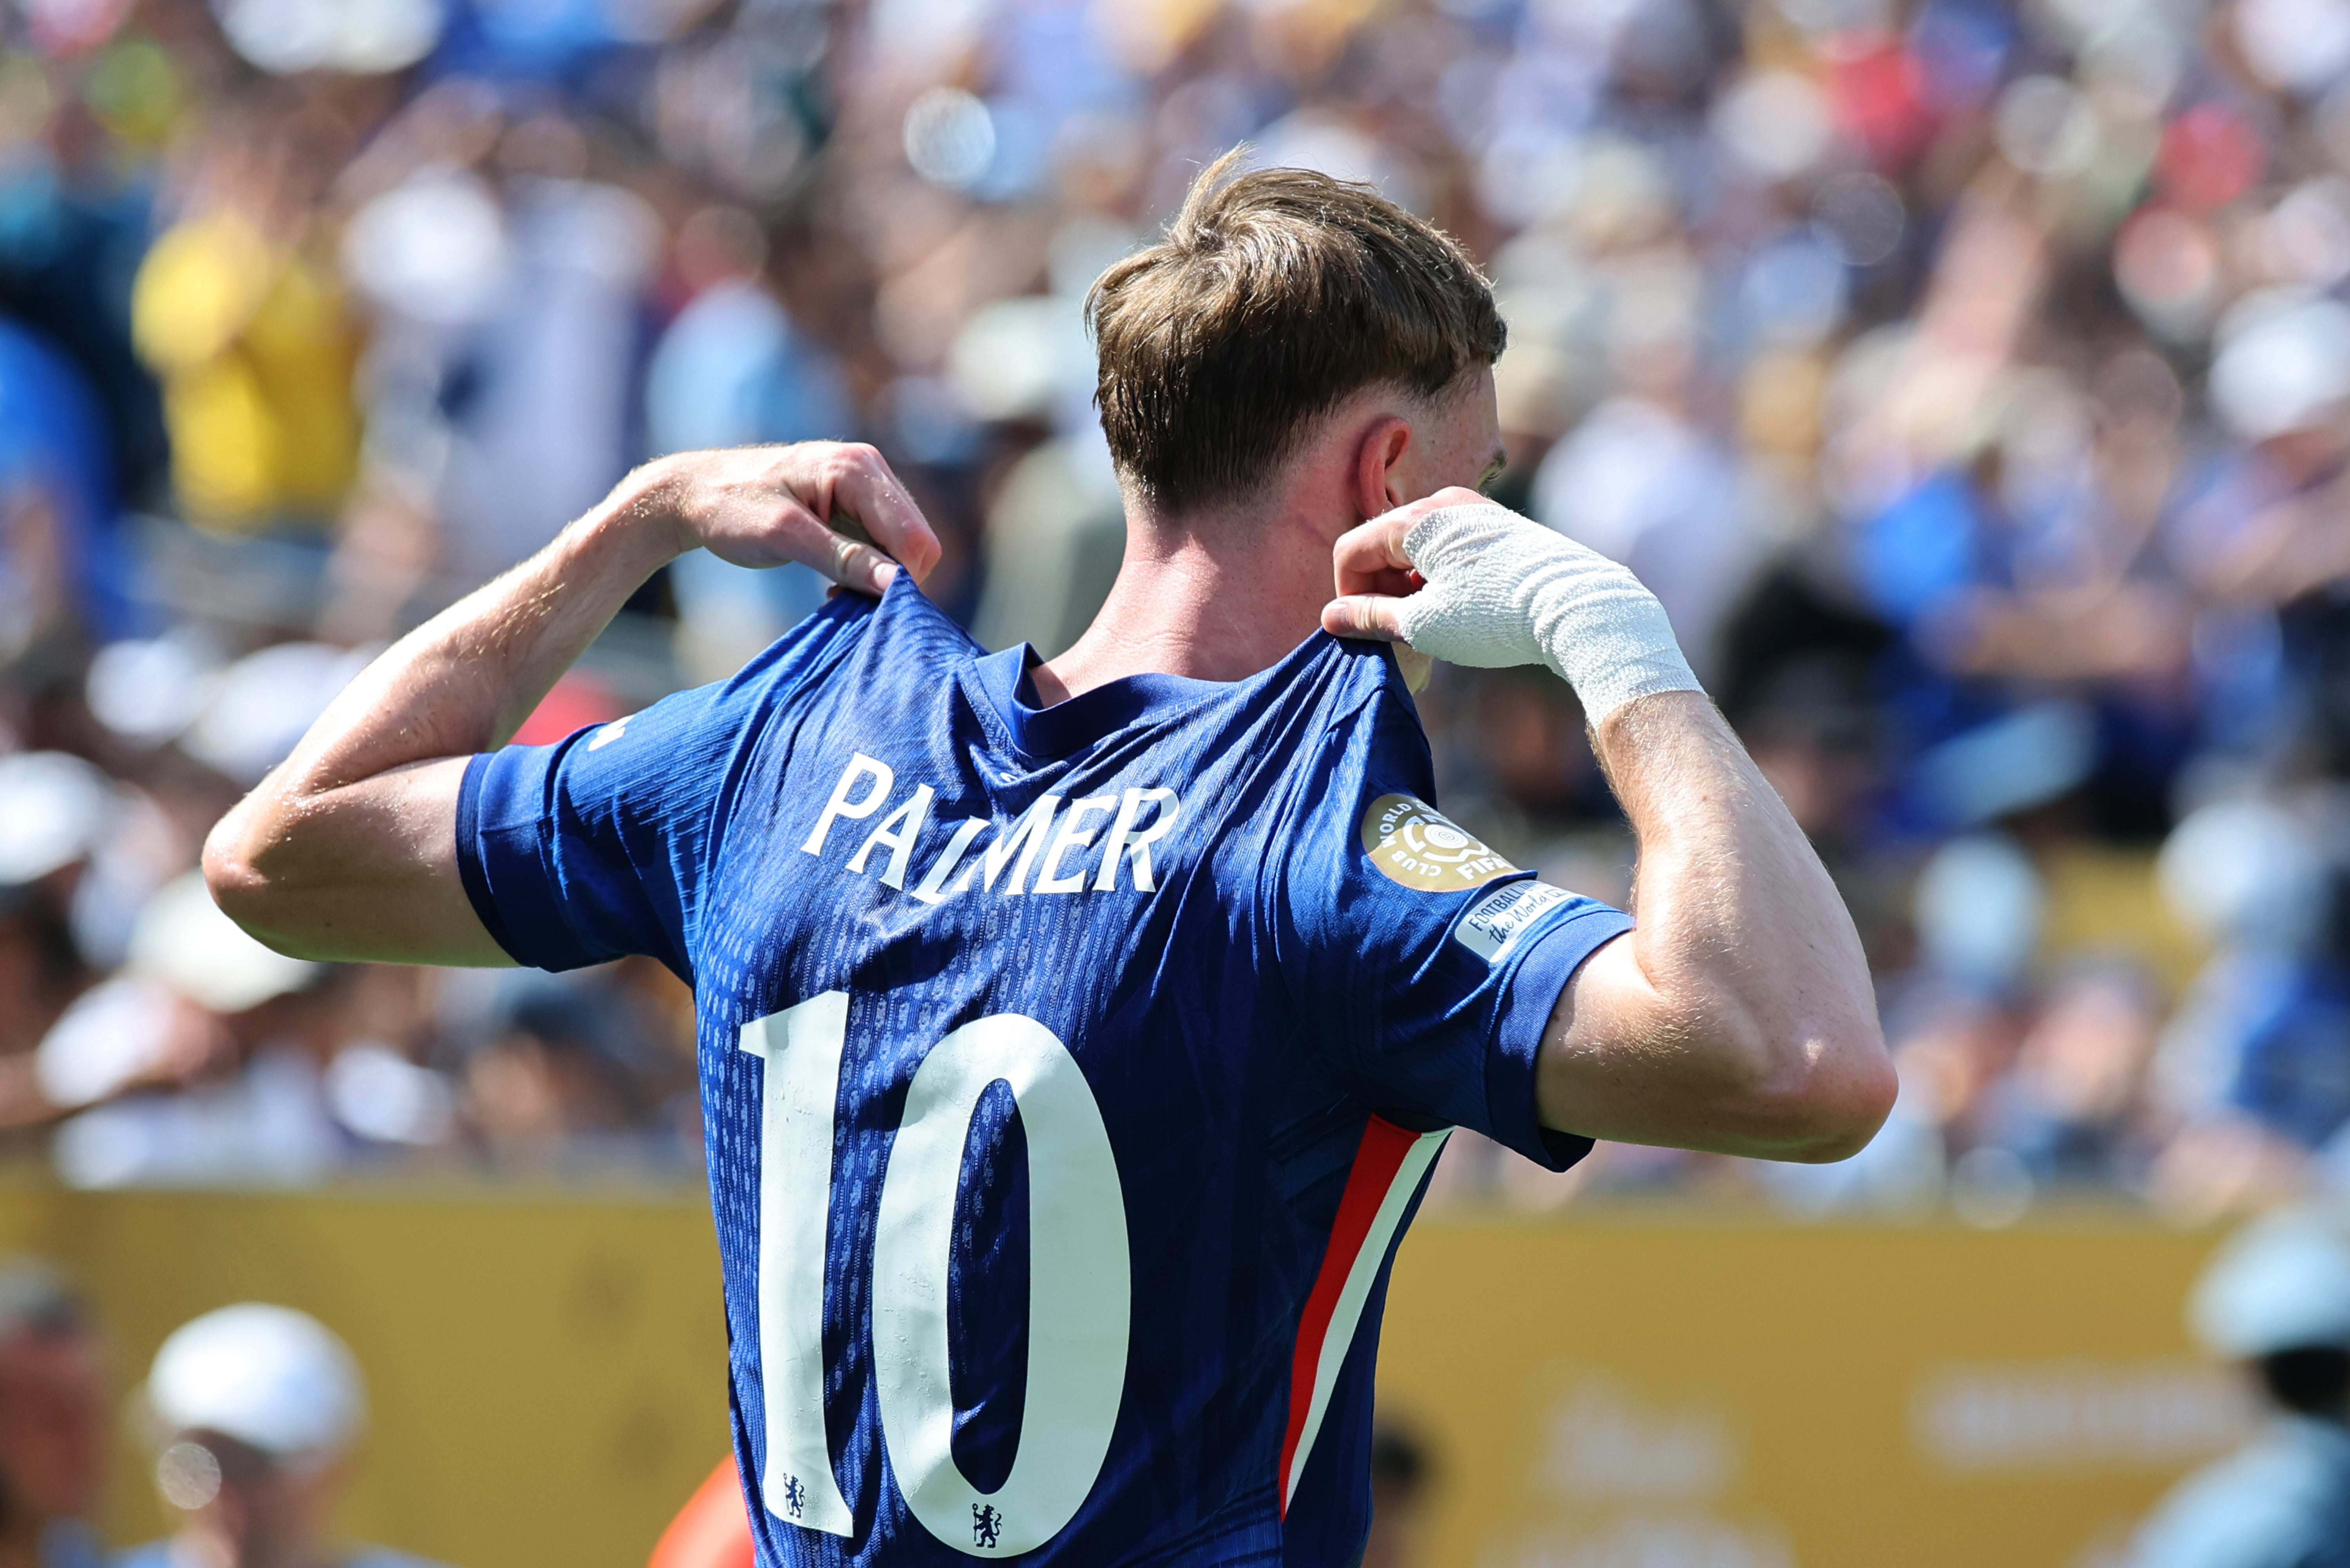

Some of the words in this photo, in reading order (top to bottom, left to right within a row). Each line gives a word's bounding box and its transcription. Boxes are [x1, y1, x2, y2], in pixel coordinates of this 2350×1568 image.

[800, 751, 1179, 905] PALMER
[1379, 803, 1412, 848] WORLD
[1391, 850, 1442, 877] CLUB
[1456, 857, 1513, 881] FIFA
[1468, 887, 1526, 932] FOOTBALL
[1489, 921, 1514, 944] the
[1506, 893, 1553, 922] World
[739, 990, 1132, 1558] 10
